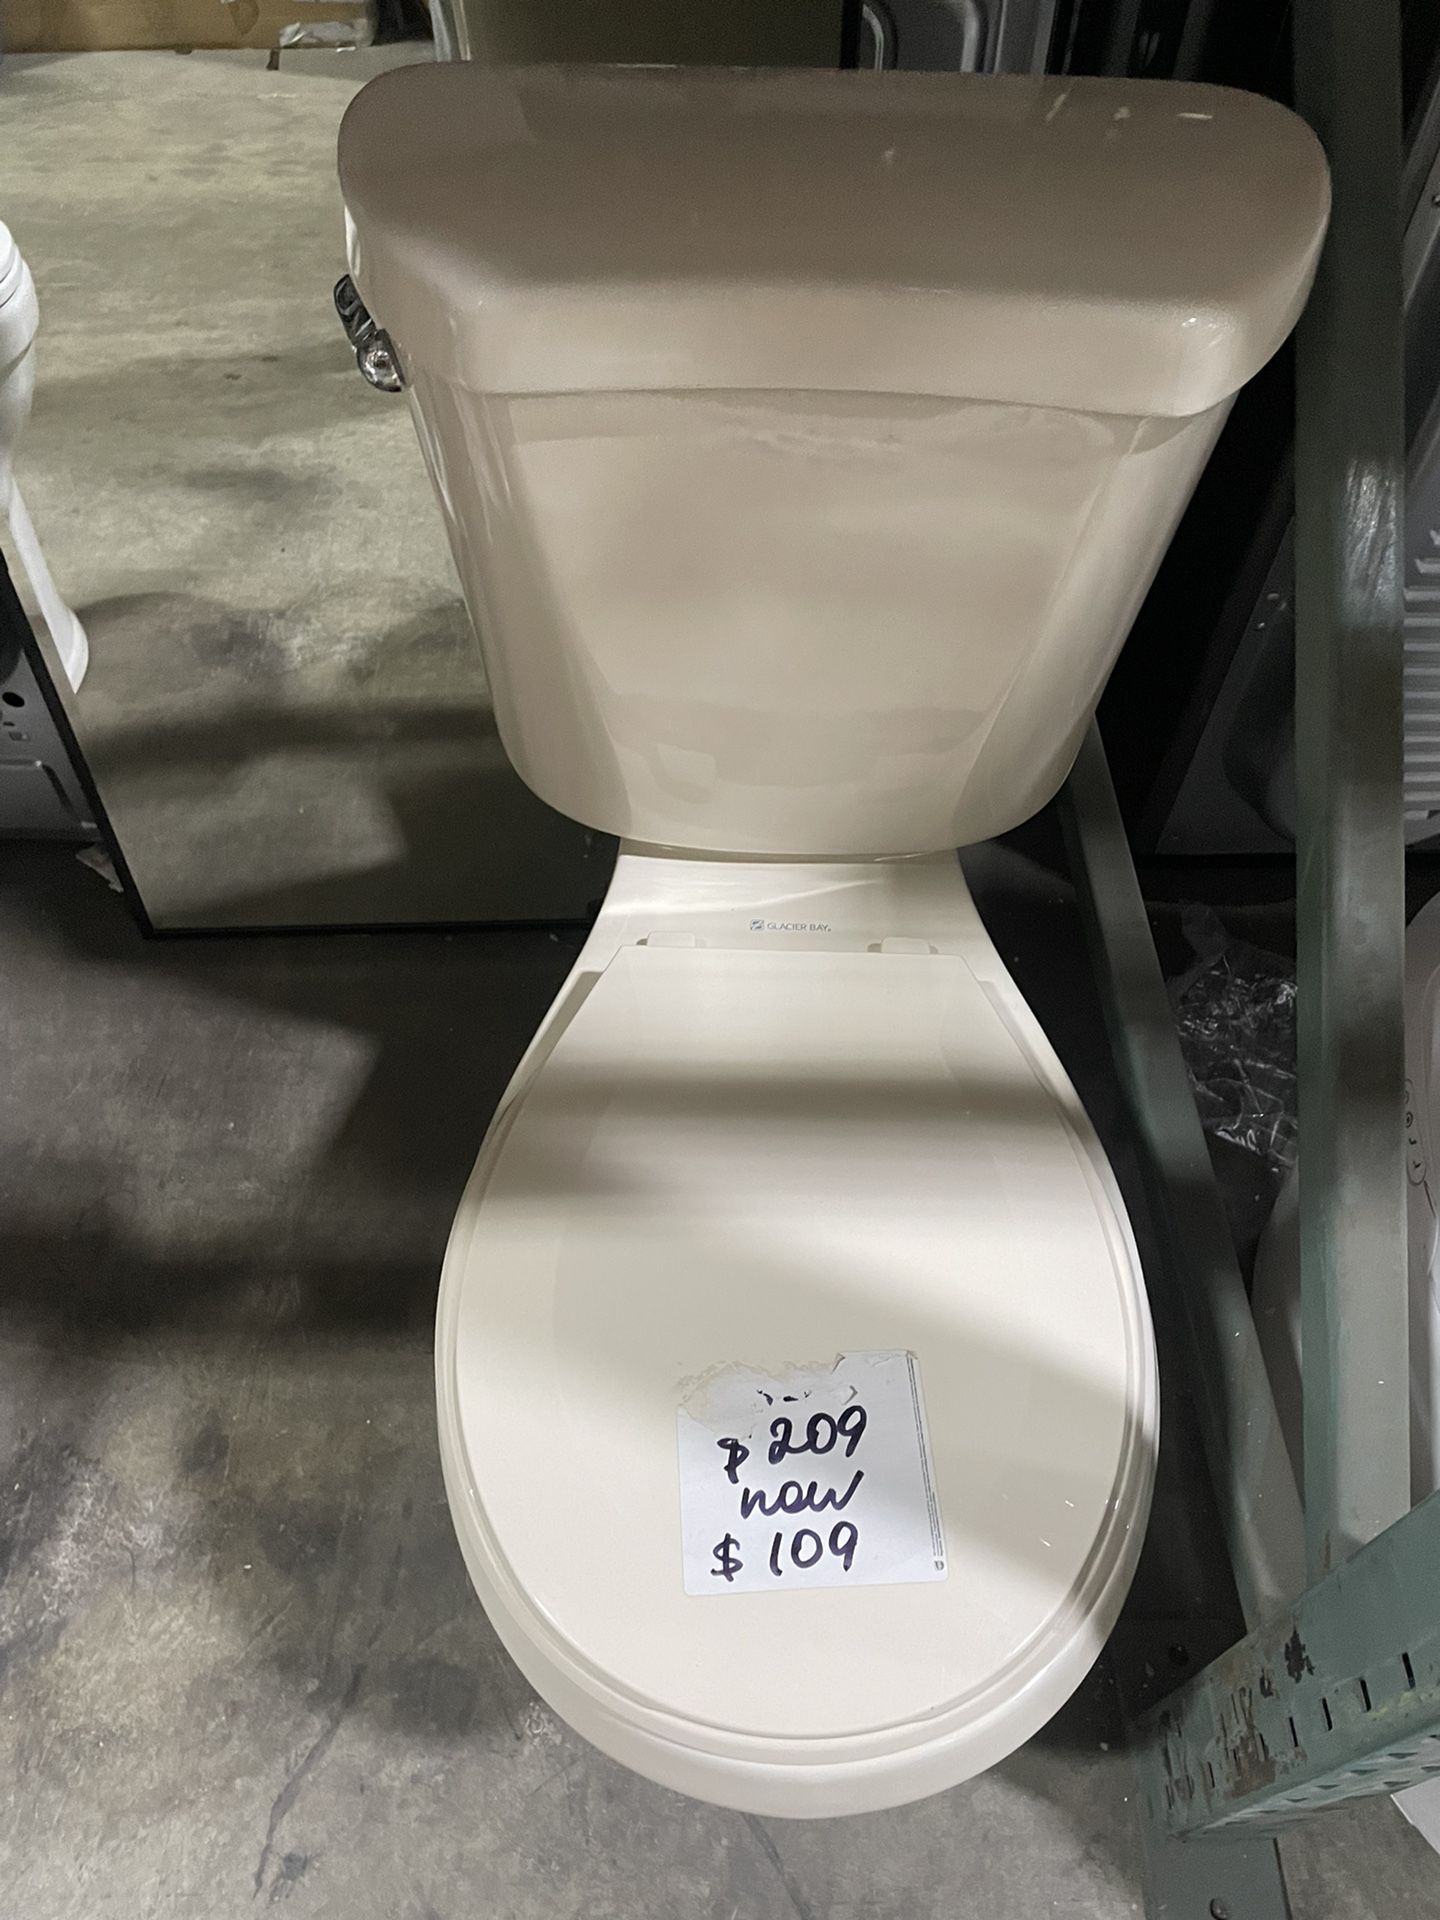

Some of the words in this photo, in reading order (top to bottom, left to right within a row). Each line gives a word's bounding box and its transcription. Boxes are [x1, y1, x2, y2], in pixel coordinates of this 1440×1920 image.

[767, 922, 807, 931] GLACIER
[768, 1405, 867, 1464] 209
[740, 1469, 864, 1519] now
[710, 1532, 743, 1582] $
[769, 1520, 858, 1576] 109
